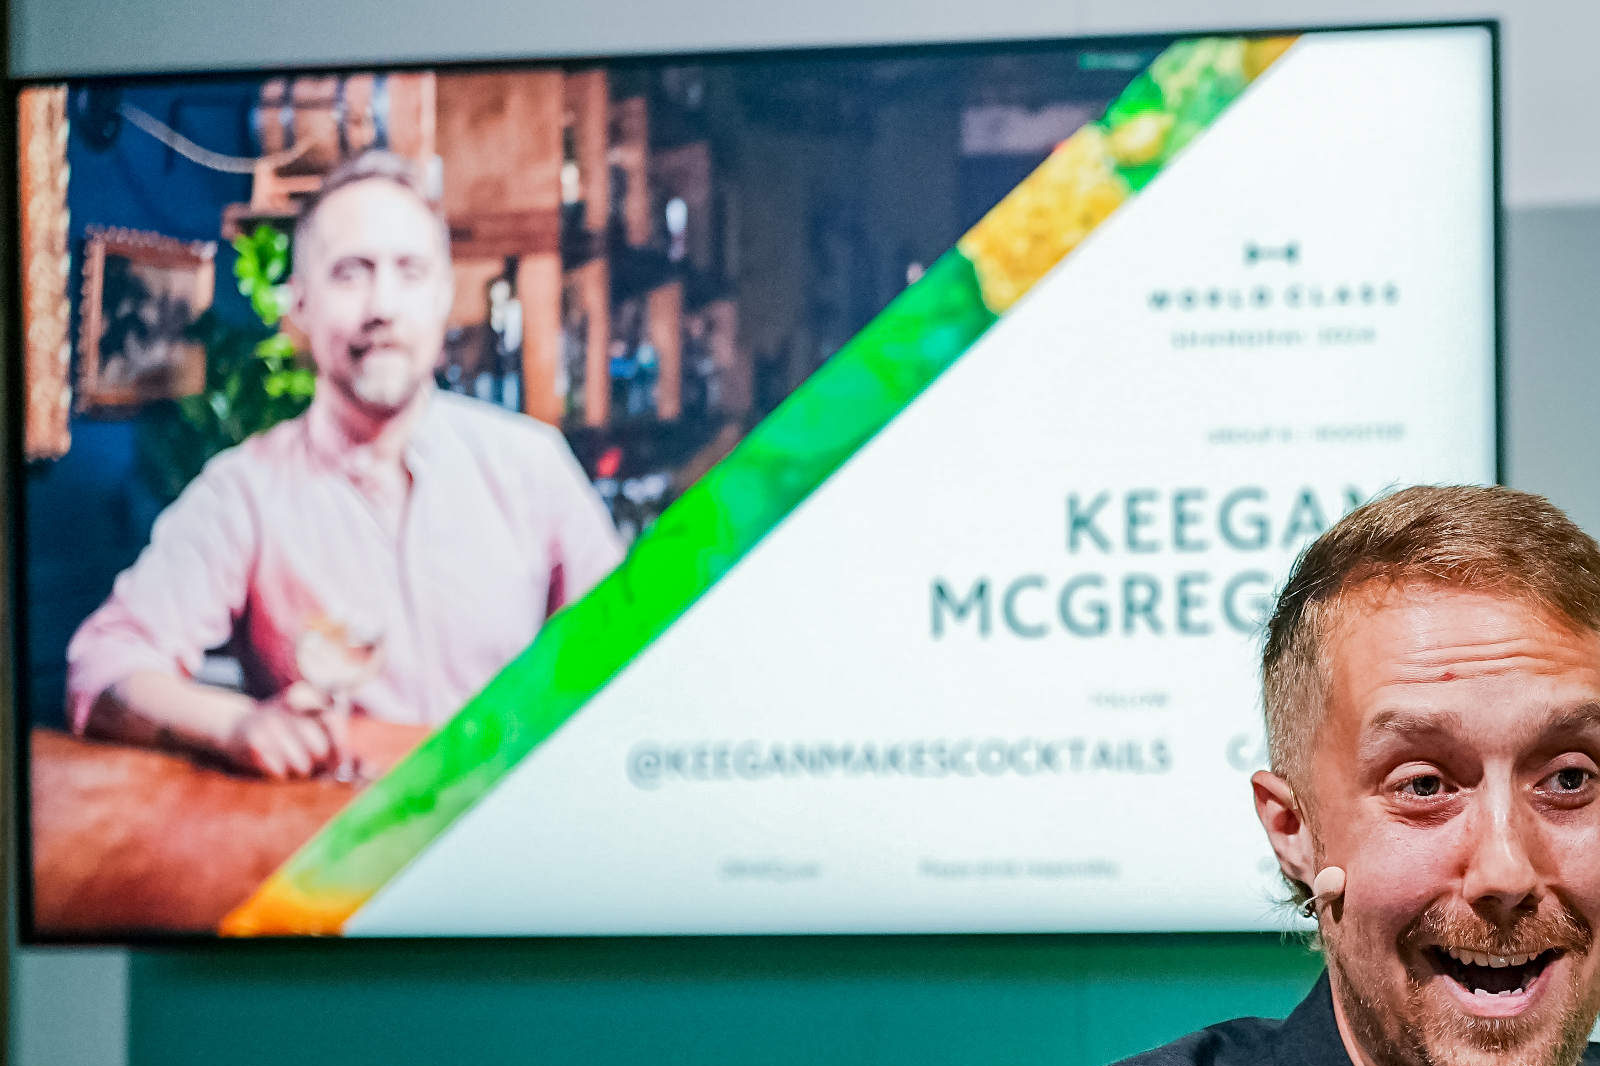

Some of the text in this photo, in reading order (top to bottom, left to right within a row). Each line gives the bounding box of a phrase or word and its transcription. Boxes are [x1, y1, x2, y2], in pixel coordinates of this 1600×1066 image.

[1147, 280, 1400, 312] WORLD CLASS
[1065, 484, 1368, 554] KEEGA
[929, 569, 1274, 639] MCGREG
[626, 737, 1172, 791] @KEEGANMAKESCOCKTAILS
